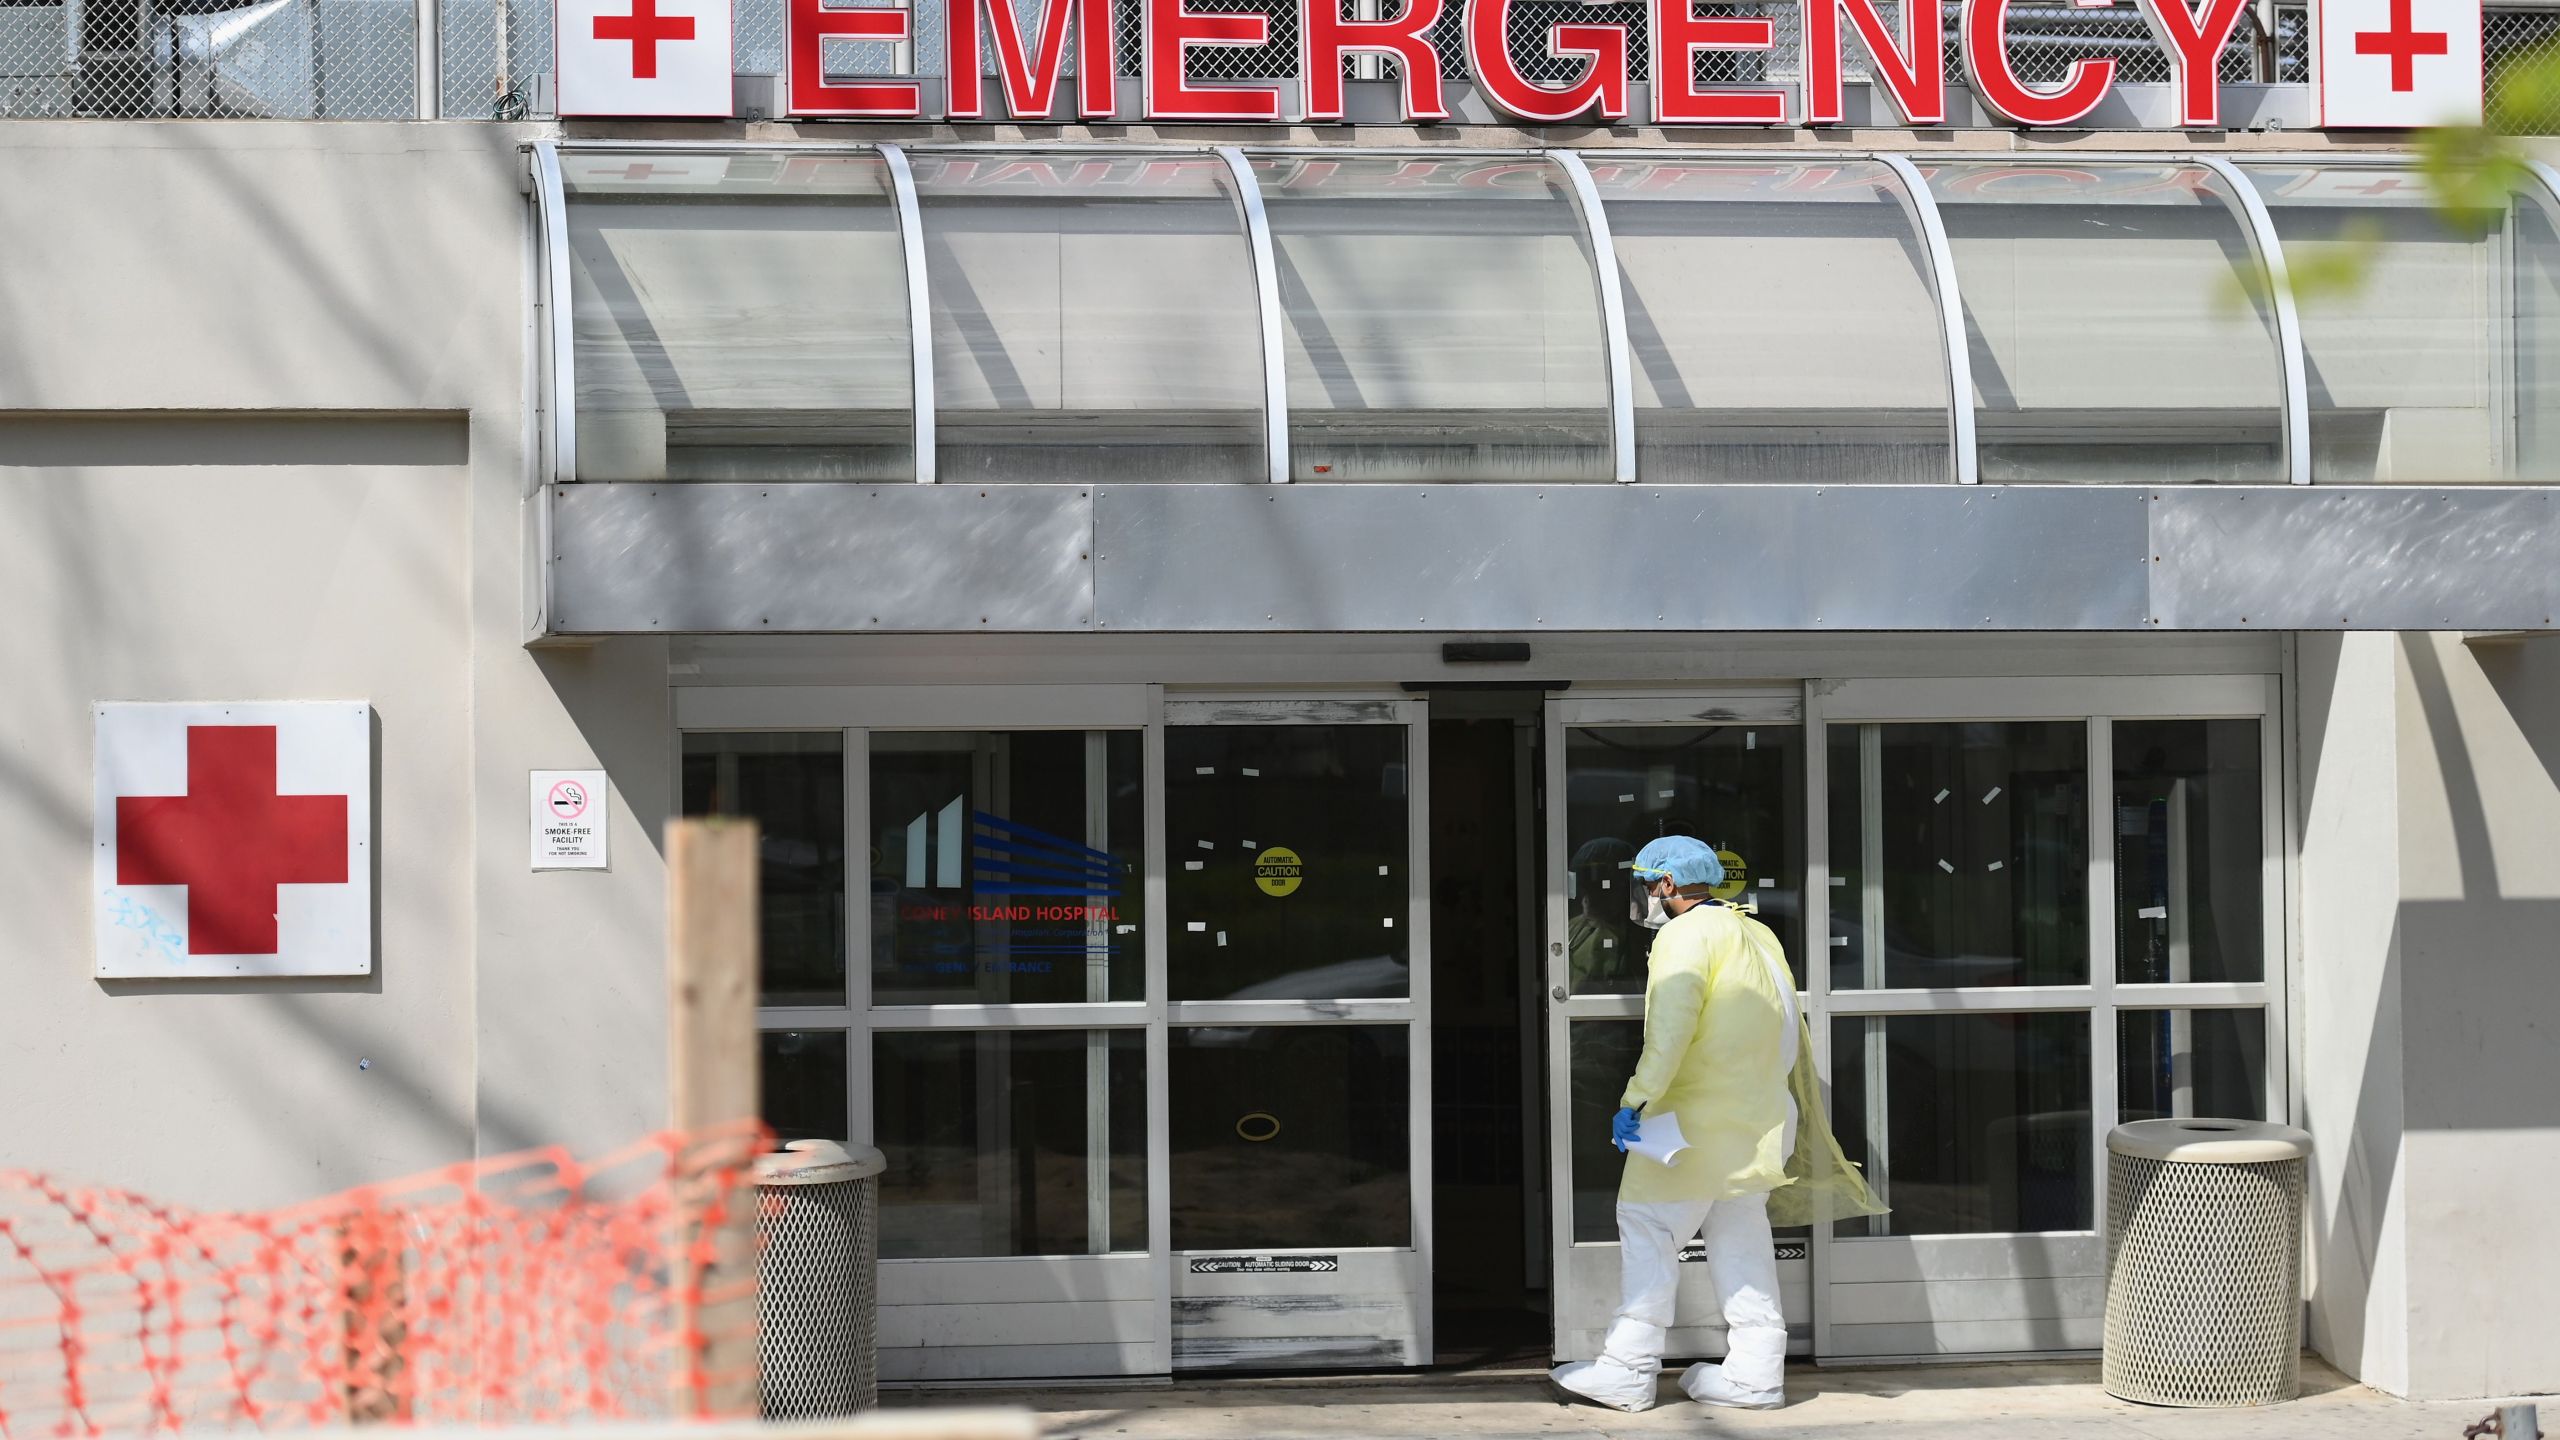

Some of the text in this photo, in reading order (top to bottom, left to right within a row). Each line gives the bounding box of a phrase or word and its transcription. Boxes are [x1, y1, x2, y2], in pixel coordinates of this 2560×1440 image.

[785, 0, 2249, 127] EMERGENCY
[1258, 866, 1299, 876] CAUTION
[1724, 870, 1744, 879] TION
[967, 906, 1031, 921] ISLAND
[1036, 906, 1120, 921] HOSPITAL
